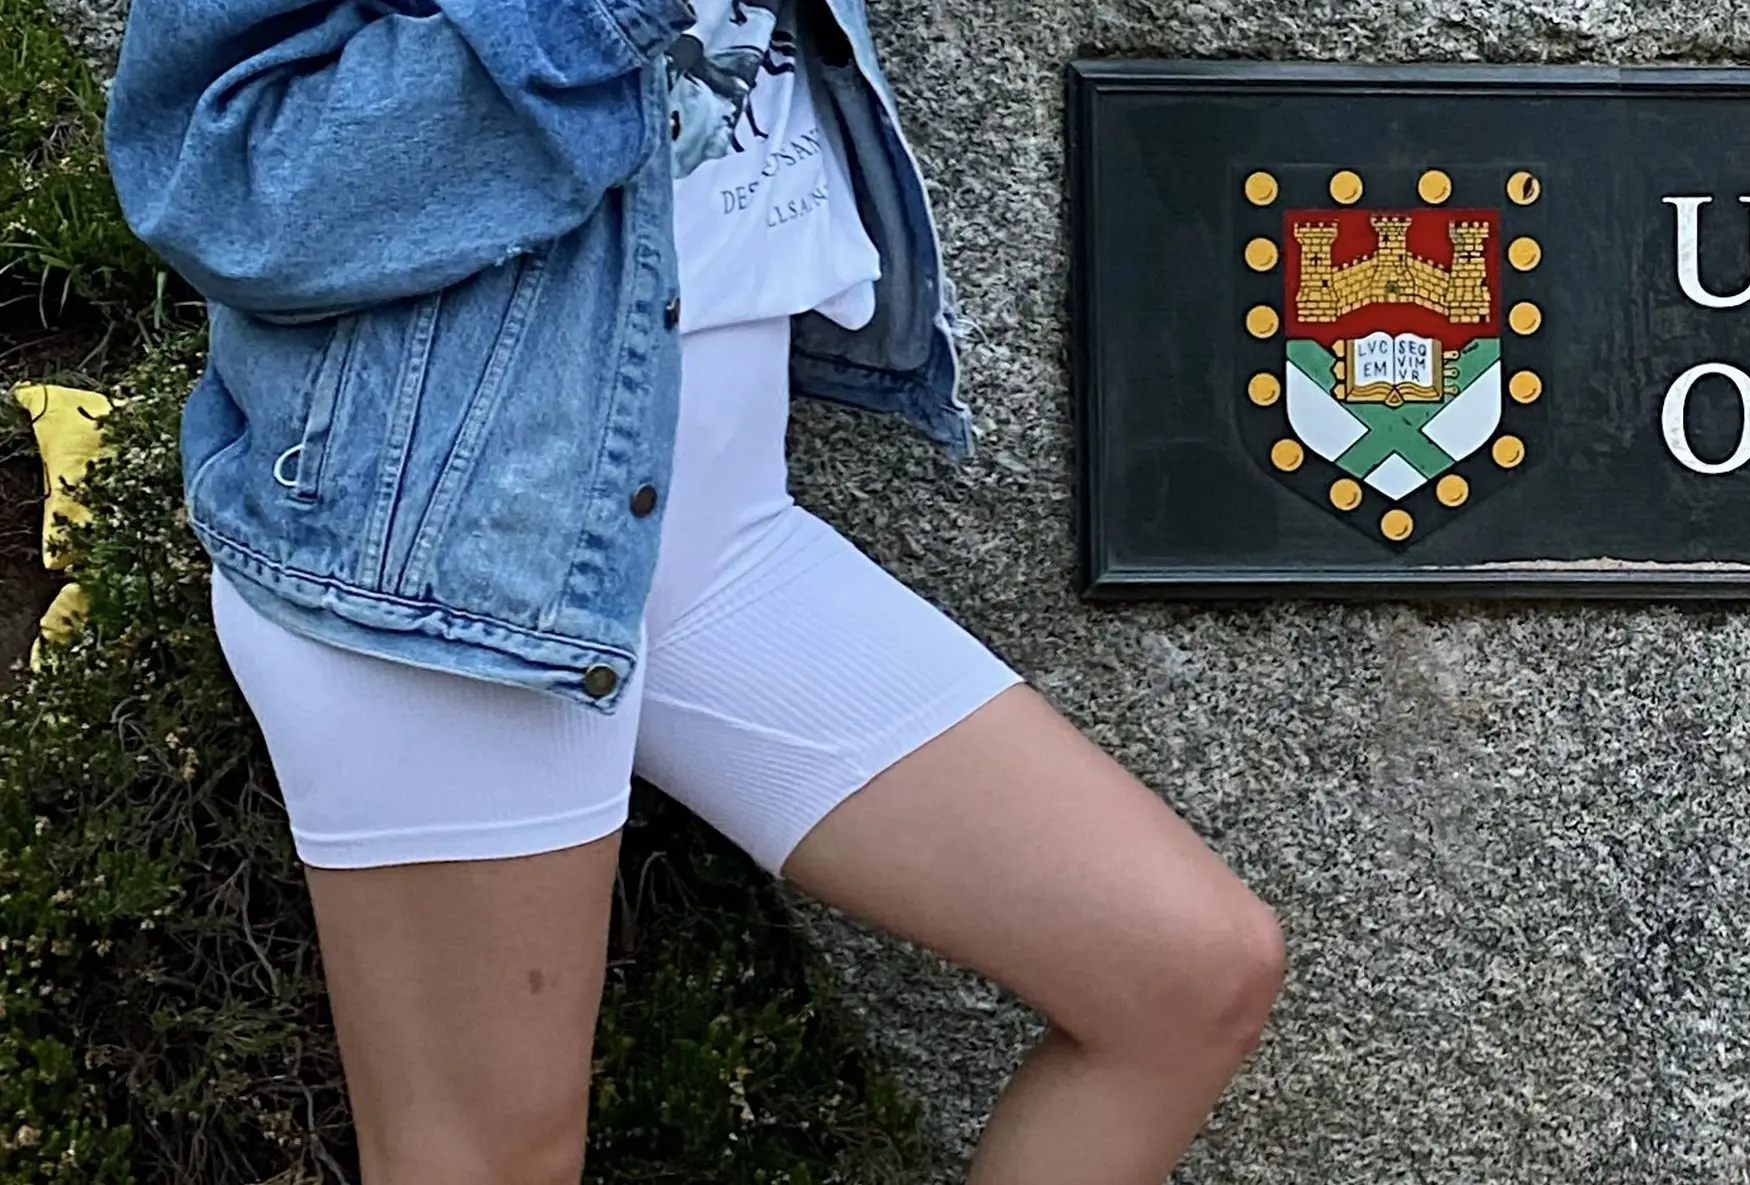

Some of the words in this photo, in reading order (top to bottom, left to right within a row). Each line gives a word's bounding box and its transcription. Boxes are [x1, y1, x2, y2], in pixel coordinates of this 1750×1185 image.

[1358, 339, 1388, 357] LVC
[1363, 360, 1387, 377] EM
[1397, 356, 1426, 370] VIM
[1398, 369, 1420, 383] VR
